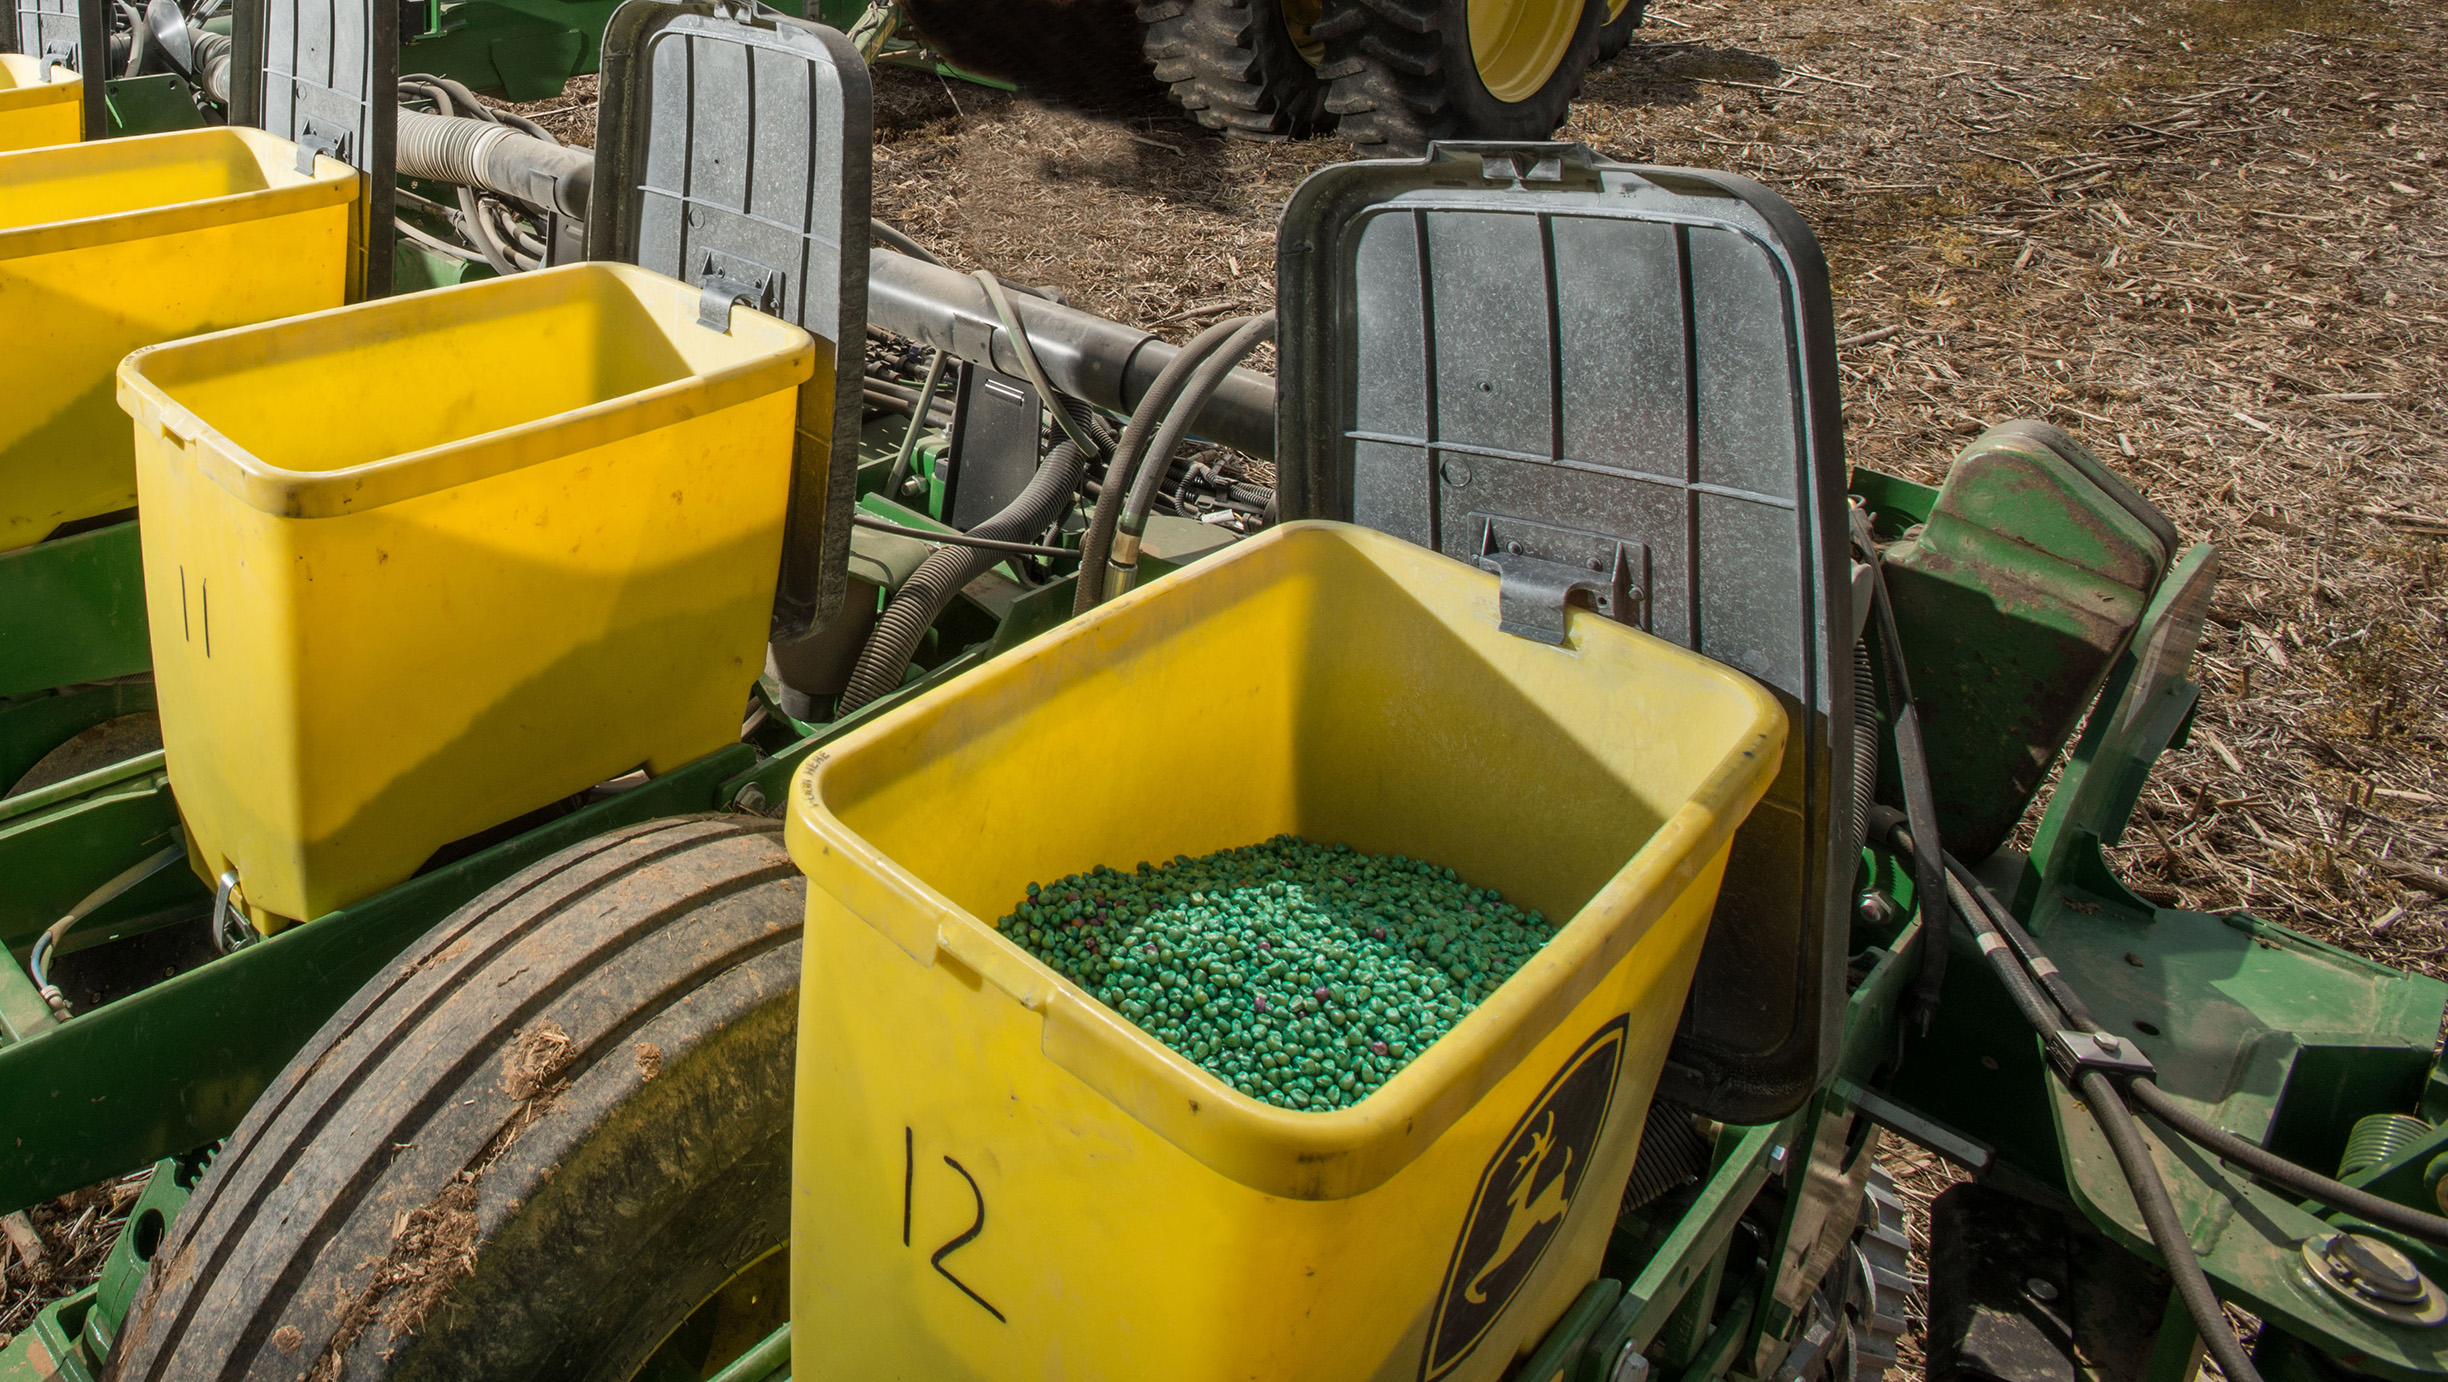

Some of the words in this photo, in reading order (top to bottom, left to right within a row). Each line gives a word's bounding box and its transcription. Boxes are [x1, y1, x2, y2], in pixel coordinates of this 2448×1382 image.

[179, 564, 211, 659] 11
[804, 750, 831, 776] HERE
[903, 1126, 1007, 1324] 12
